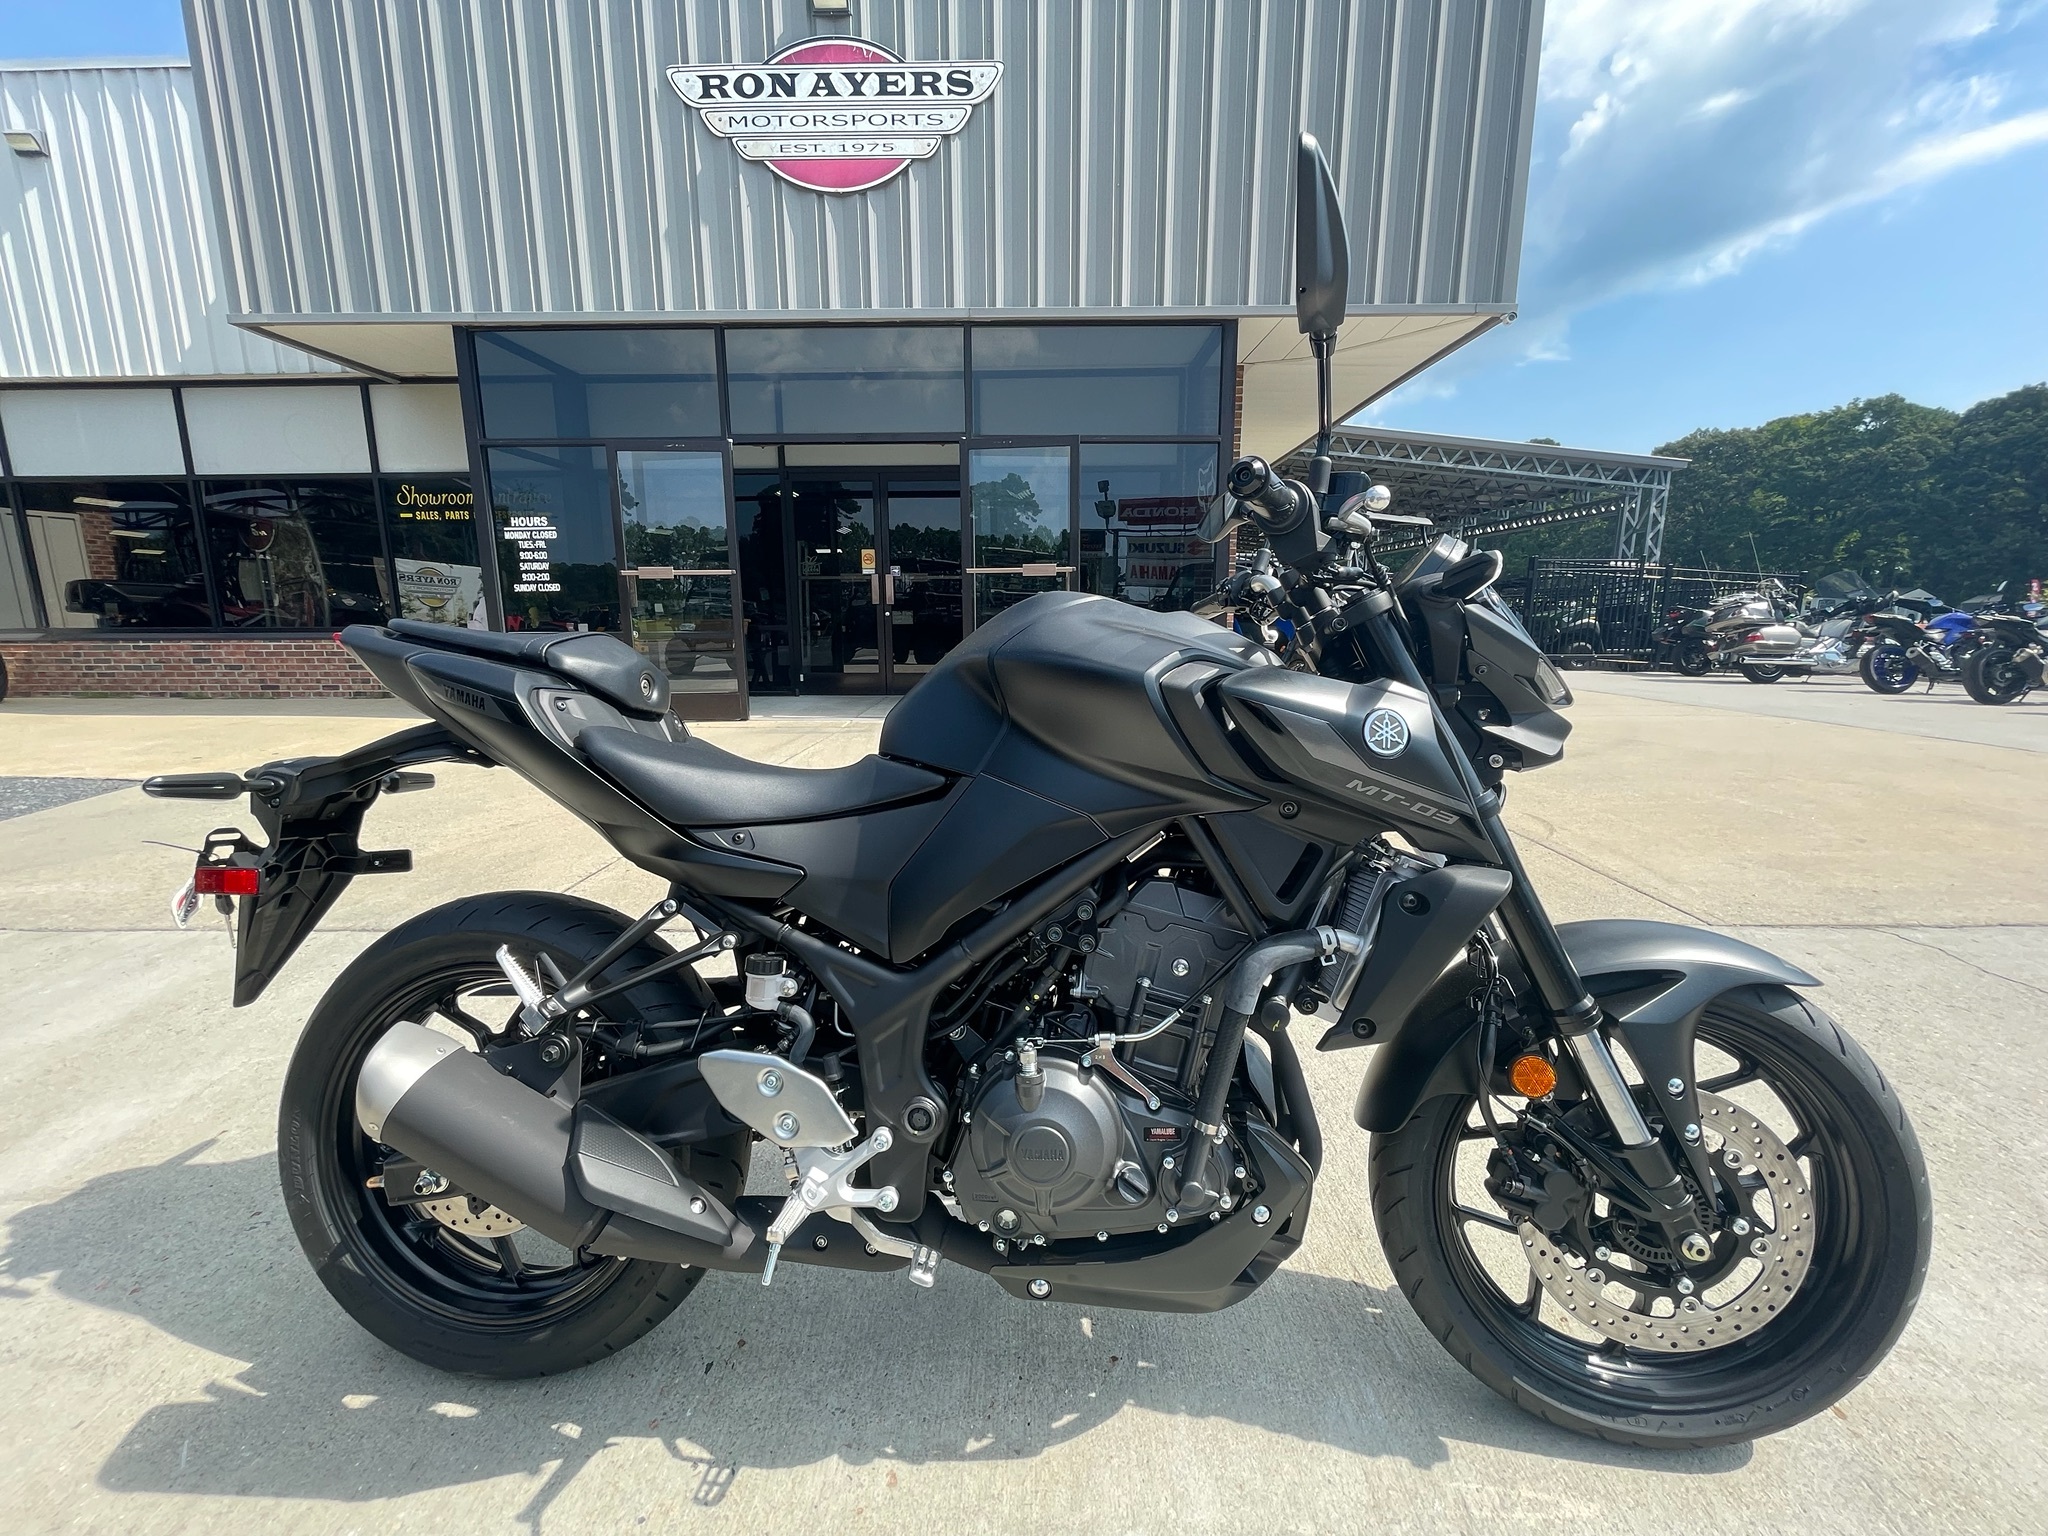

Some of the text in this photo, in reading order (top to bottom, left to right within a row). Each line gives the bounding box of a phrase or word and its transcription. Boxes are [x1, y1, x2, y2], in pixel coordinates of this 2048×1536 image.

[697, 69, 975, 99] RON AYERS
[728, 113, 944, 129] MOTORSPORTS
[778, 142, 895, 154] EST. 1975
[415, 511, 470, 521] SALES, PARTS
[510, 516, 548, 527] HOURS
[504, 530, 558, 539] MONDAY CLOSED
[519, 562, 550, 570] SATURDAY
[513, 583, 561, 592] SUNDAY CLOSED
[442, 684, 486, 711] YAMAHA
[1345, 779, 1461, 825] MT-03
[1021, 1148, 1064, 1161] YAMAHA
